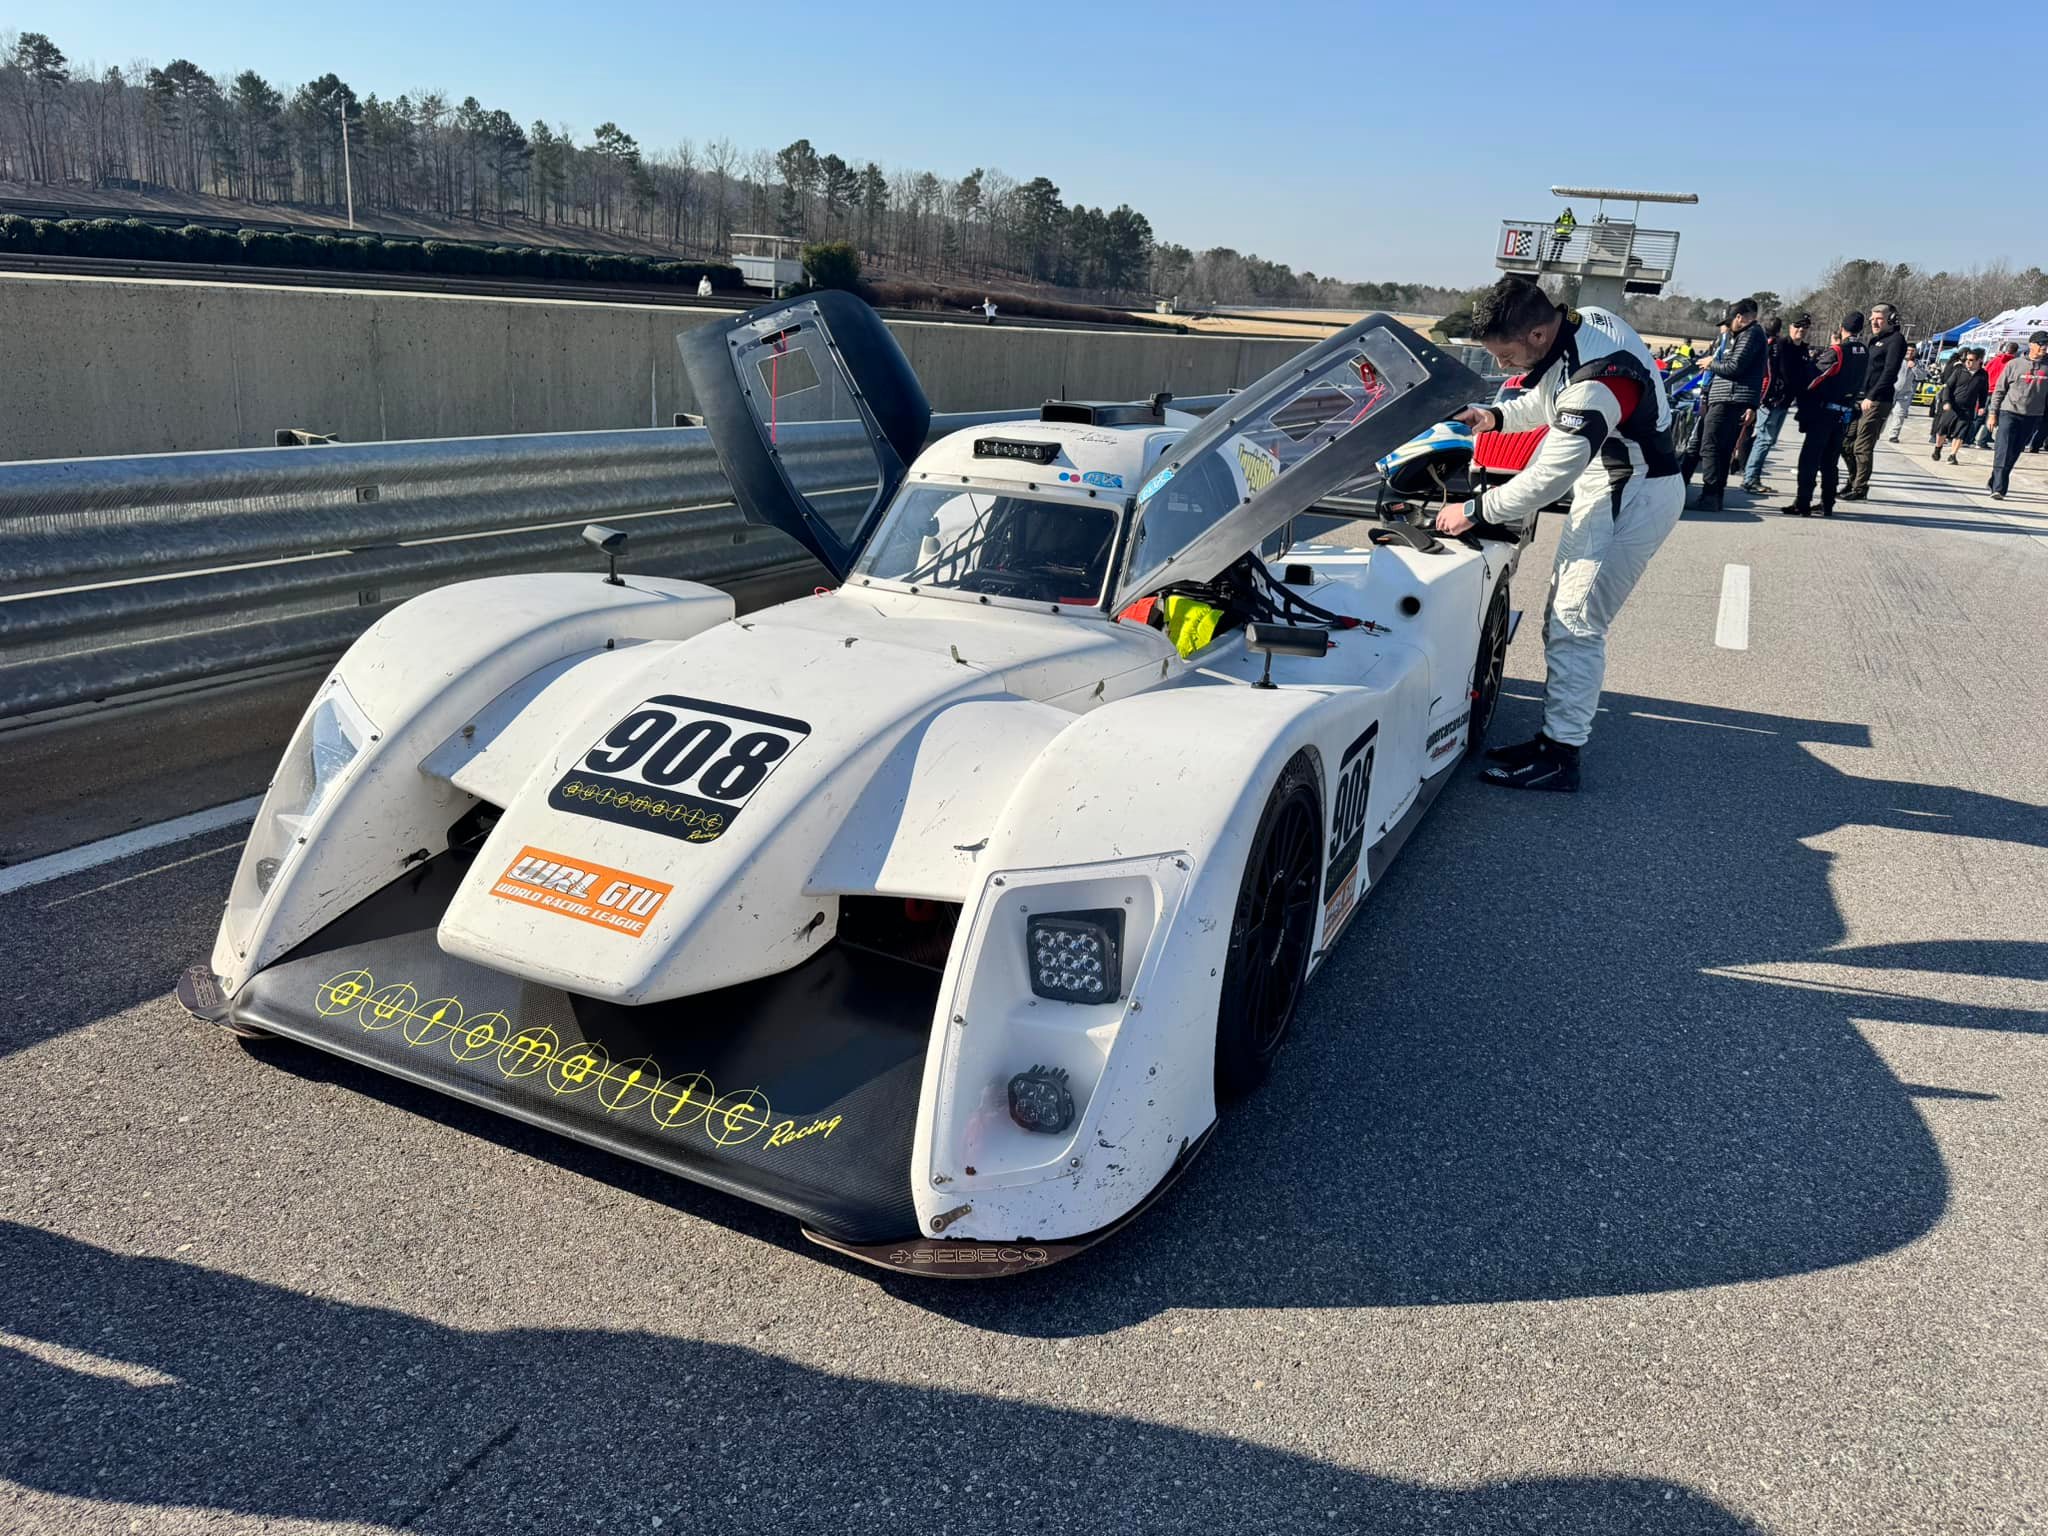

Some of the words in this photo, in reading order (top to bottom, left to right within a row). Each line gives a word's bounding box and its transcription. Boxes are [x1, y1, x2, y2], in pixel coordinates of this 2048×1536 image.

[1560, 413, 1583, 427] OMP
[585, 709, 790, 801] 908
[562, 781, 723, 832] automatic
[1330, 745, 1375, 860] 908
[495, 882, 542, 903] WORLD
[542, 894, 592, 916] RACING
[589, 910, 645, 932] LEAGUE
[507, 855, 599, 899] WRL
[597, 880, 664, 917] GTU
[316, 970, 770, 1145] automatic
[763, 1114, 842, 1150] Racing
[912, 1247, 1048, 1263] SEBECO
